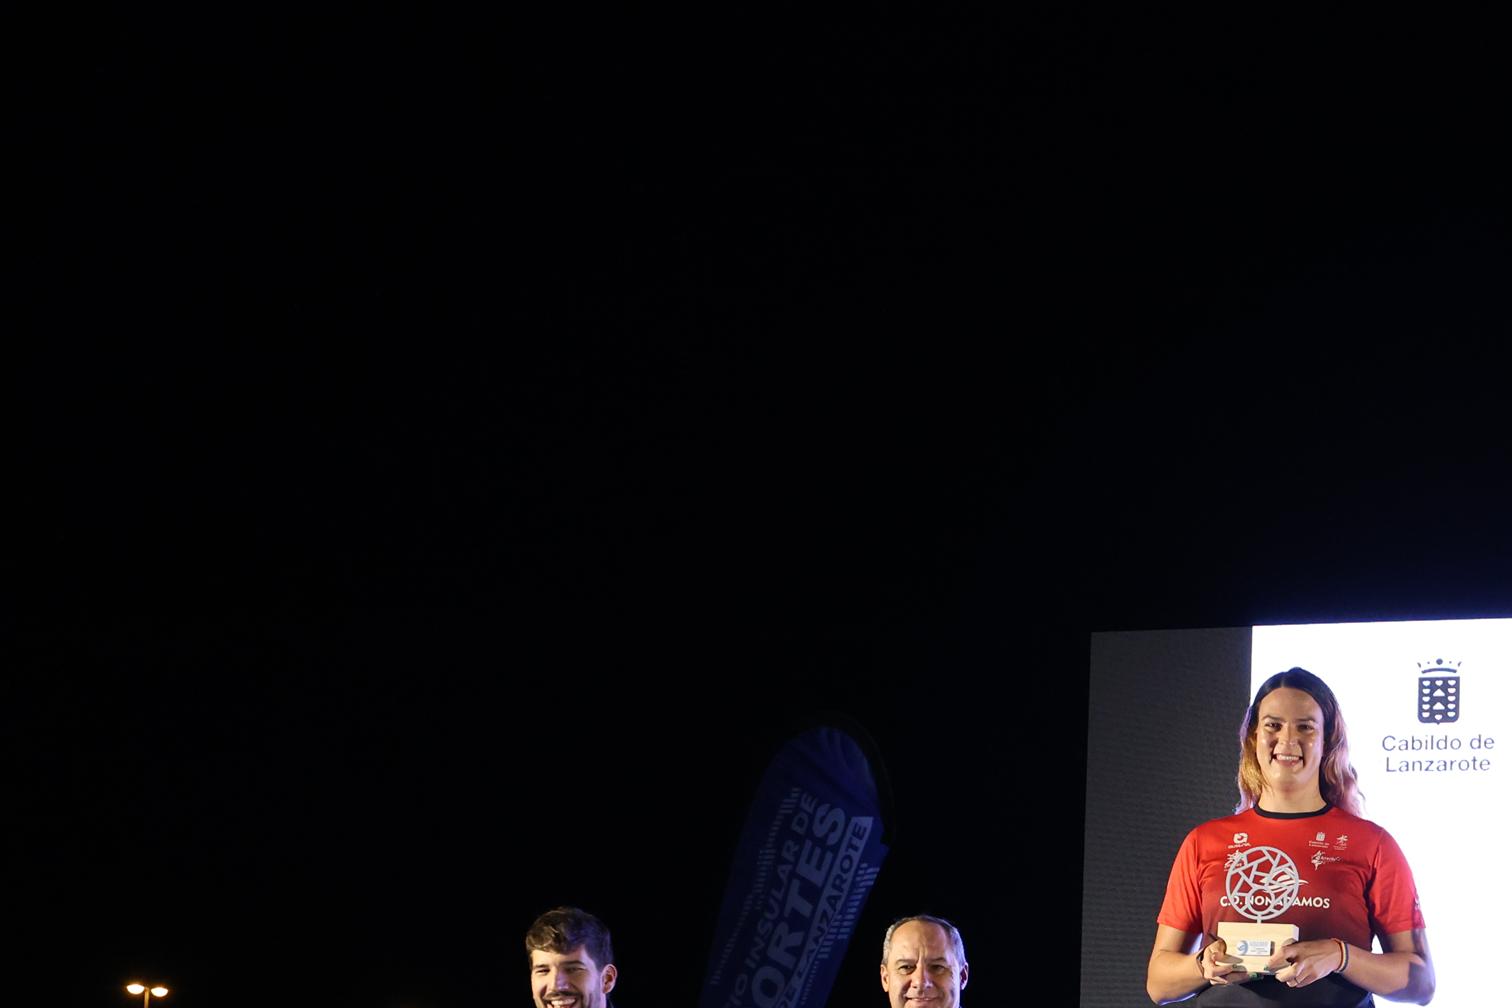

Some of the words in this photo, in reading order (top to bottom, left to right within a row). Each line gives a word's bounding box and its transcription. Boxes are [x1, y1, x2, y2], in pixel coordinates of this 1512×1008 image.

[1382, 735, 1462, 751] Cabildo
[1469, 734, 1496, 750] de
[1385, 756, 1491, 772] Lanzarote
[744, 840, 800, 969] INSULAR
[791, 792, 818, 835] DE
